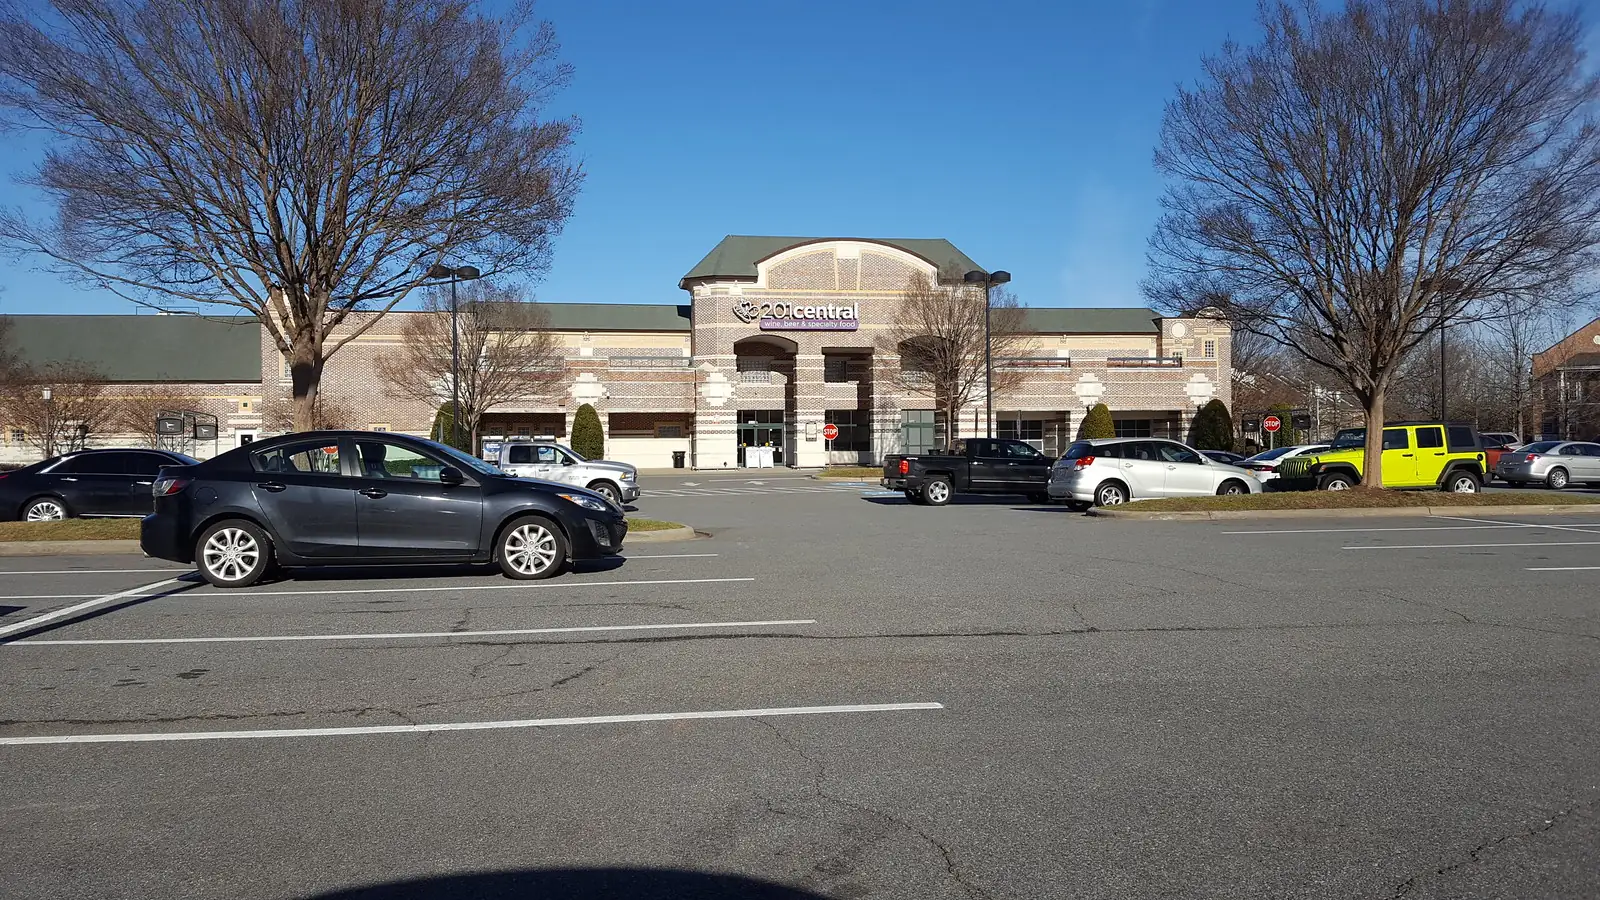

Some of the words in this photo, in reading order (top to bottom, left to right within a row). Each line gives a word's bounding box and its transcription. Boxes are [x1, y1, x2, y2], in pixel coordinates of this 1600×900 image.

[761, 302, 859, 319] 201central
[764, 320, 782, 328] wine,
[784, 320, 800, 328] beer
[808, 320, 838, 329] specialty
[840, 320, 856, 328] food
